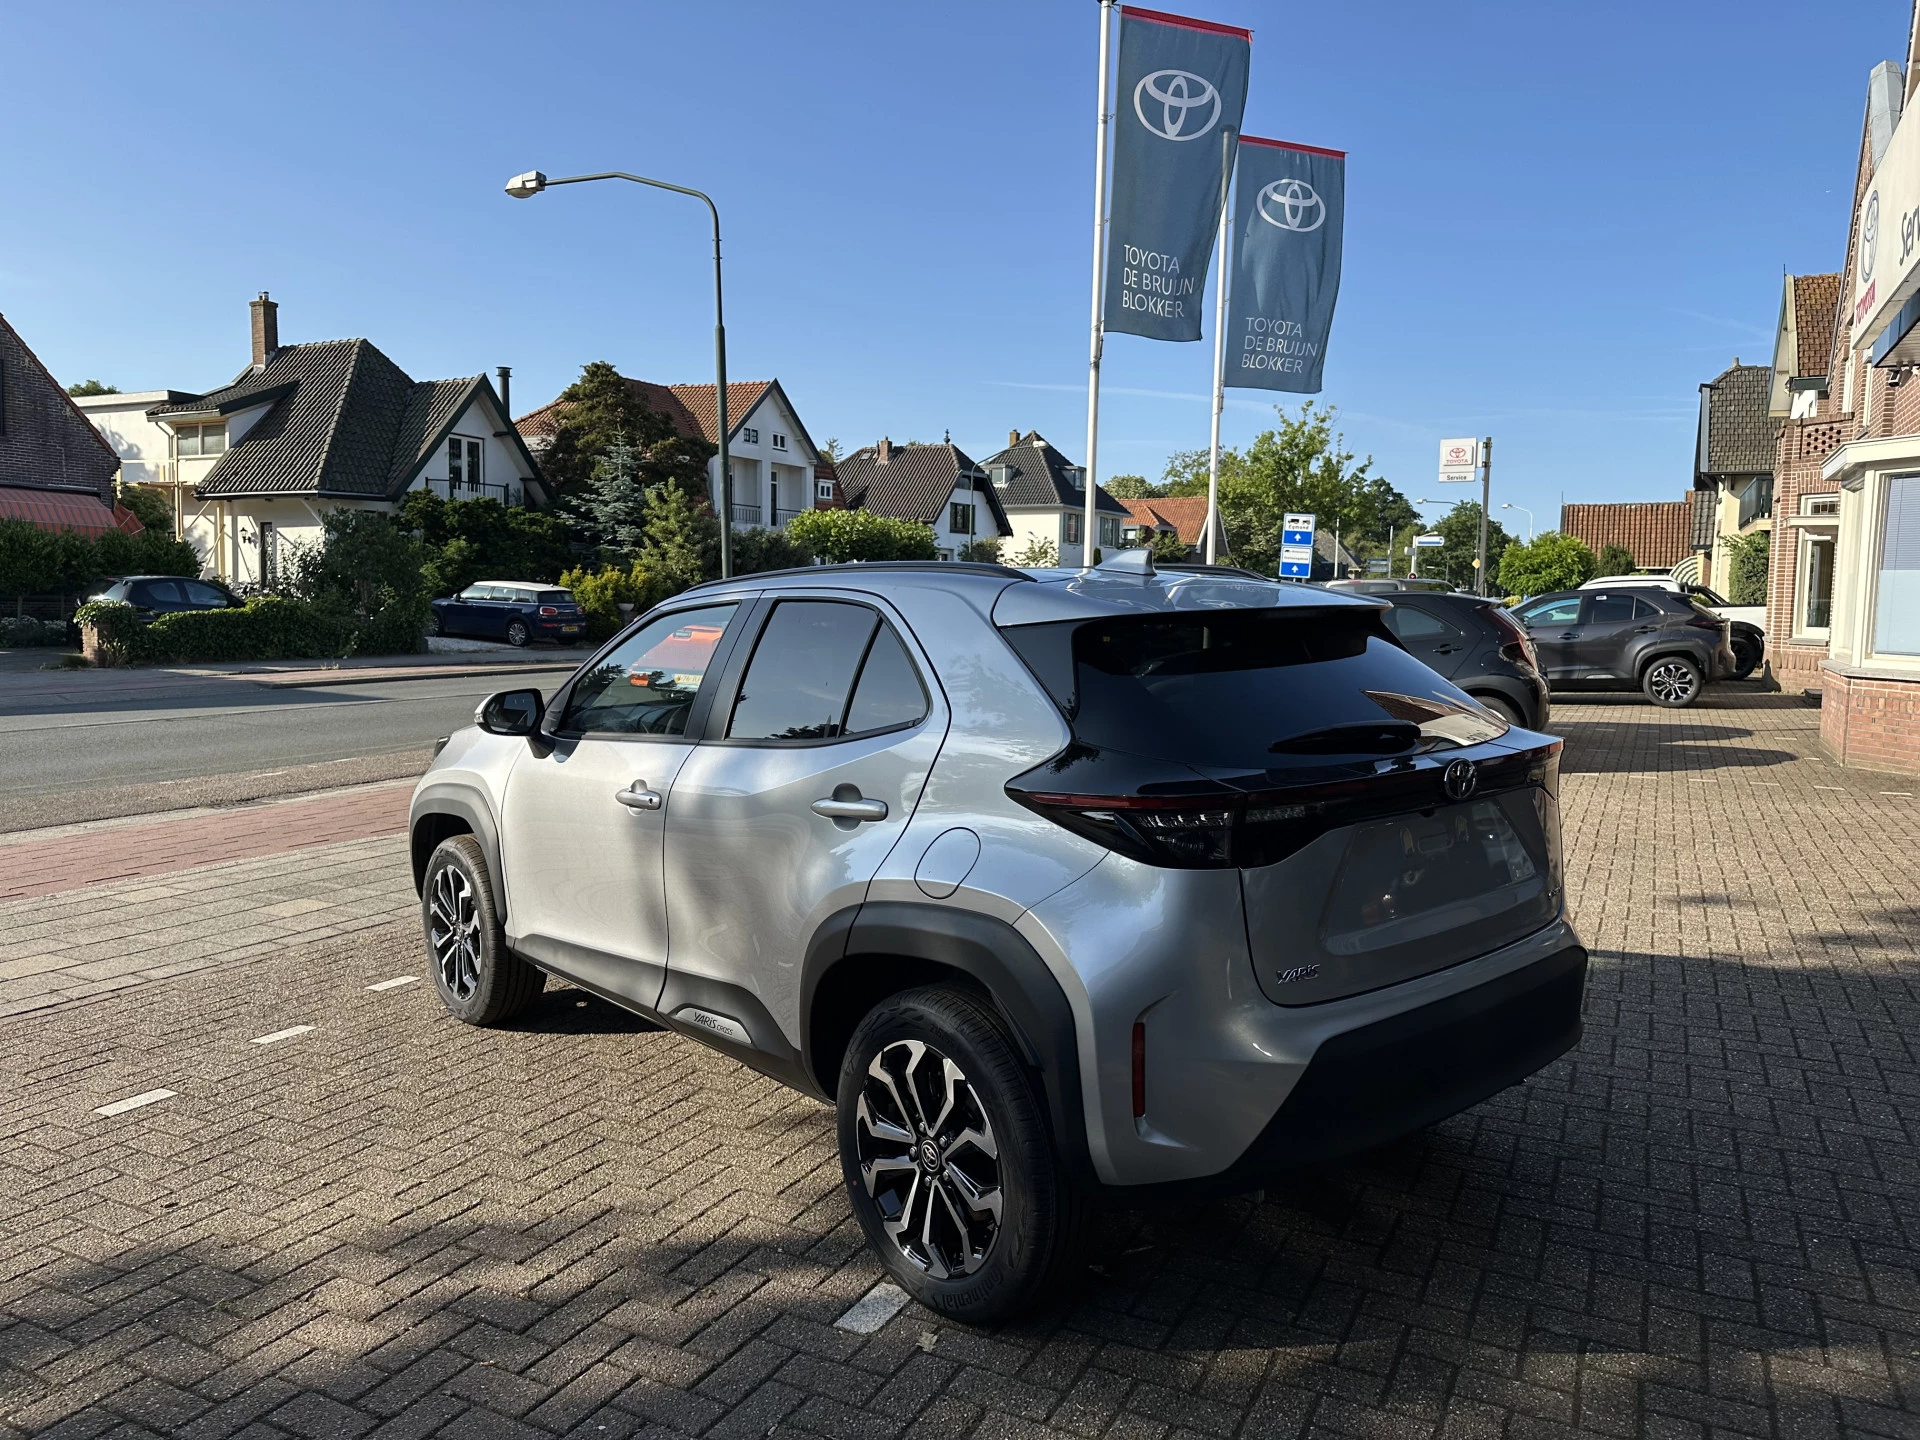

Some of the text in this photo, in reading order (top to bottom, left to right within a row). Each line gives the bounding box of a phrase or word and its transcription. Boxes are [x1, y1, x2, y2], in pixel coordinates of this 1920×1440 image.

[1123, 244, 1180, 274] TOYOTA
[1123, 267, 1195, 296] DE BRUIJN
[1122, 290, 1185, 319] BLOKKER
[1245, 317, 1303, 338] TOYOTA
[1244, 335, 1318, 357] DE BRUIJN
[1241, 353, 1303, 374] BLOKKER
